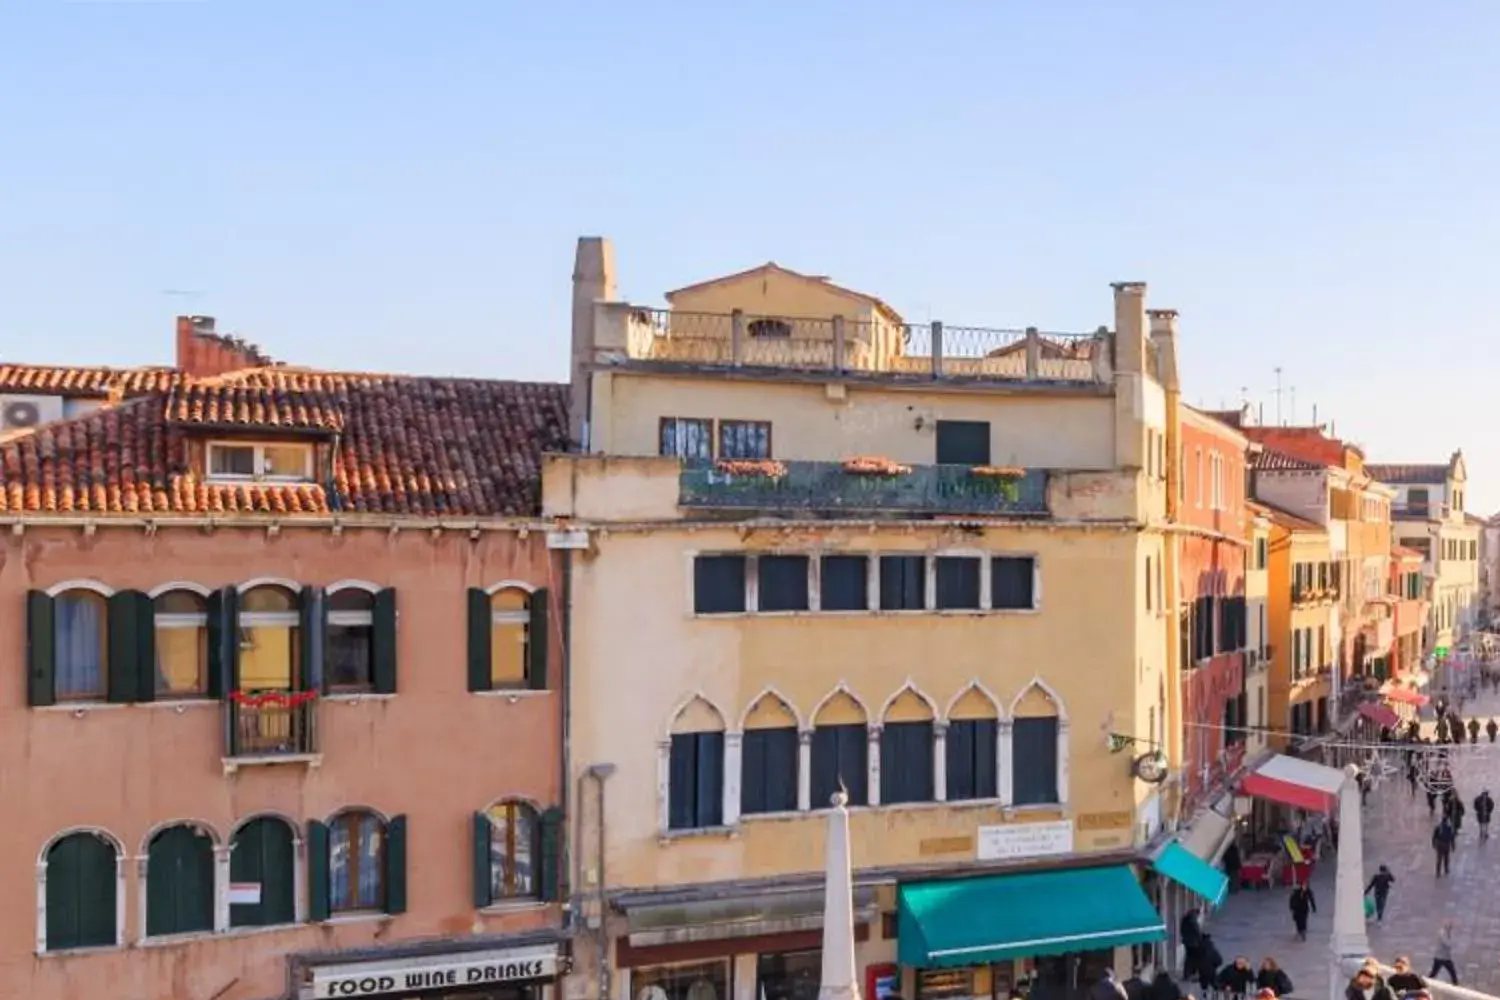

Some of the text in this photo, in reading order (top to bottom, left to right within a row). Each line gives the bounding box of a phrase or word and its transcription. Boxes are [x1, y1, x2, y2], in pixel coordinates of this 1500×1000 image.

[328, 960, 543, 996] FOOD WINE DRINKS
